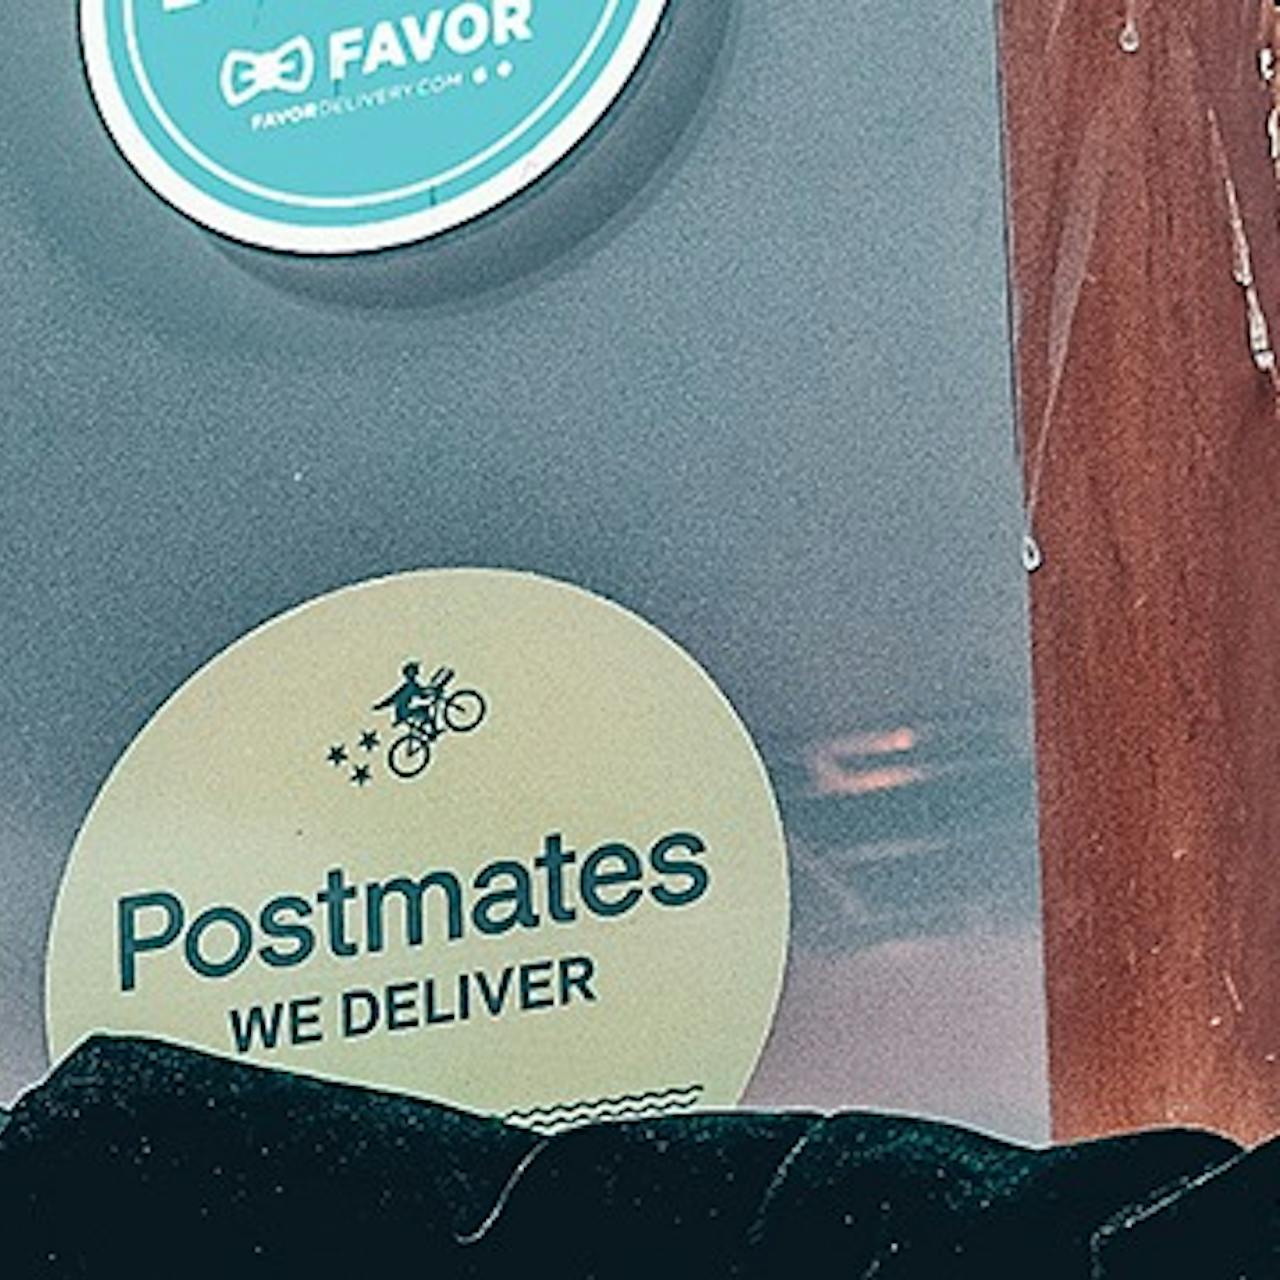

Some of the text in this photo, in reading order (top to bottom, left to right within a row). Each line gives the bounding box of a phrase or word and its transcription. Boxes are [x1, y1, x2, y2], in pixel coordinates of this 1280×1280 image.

[329, 0, 534, 81] FAVOR
[250, 73, 464, 132] FAVORDELIVERY.COM
[116, 831, 710, 991] Postmates
[230, 956, 598, 1055] WE DELIVER
